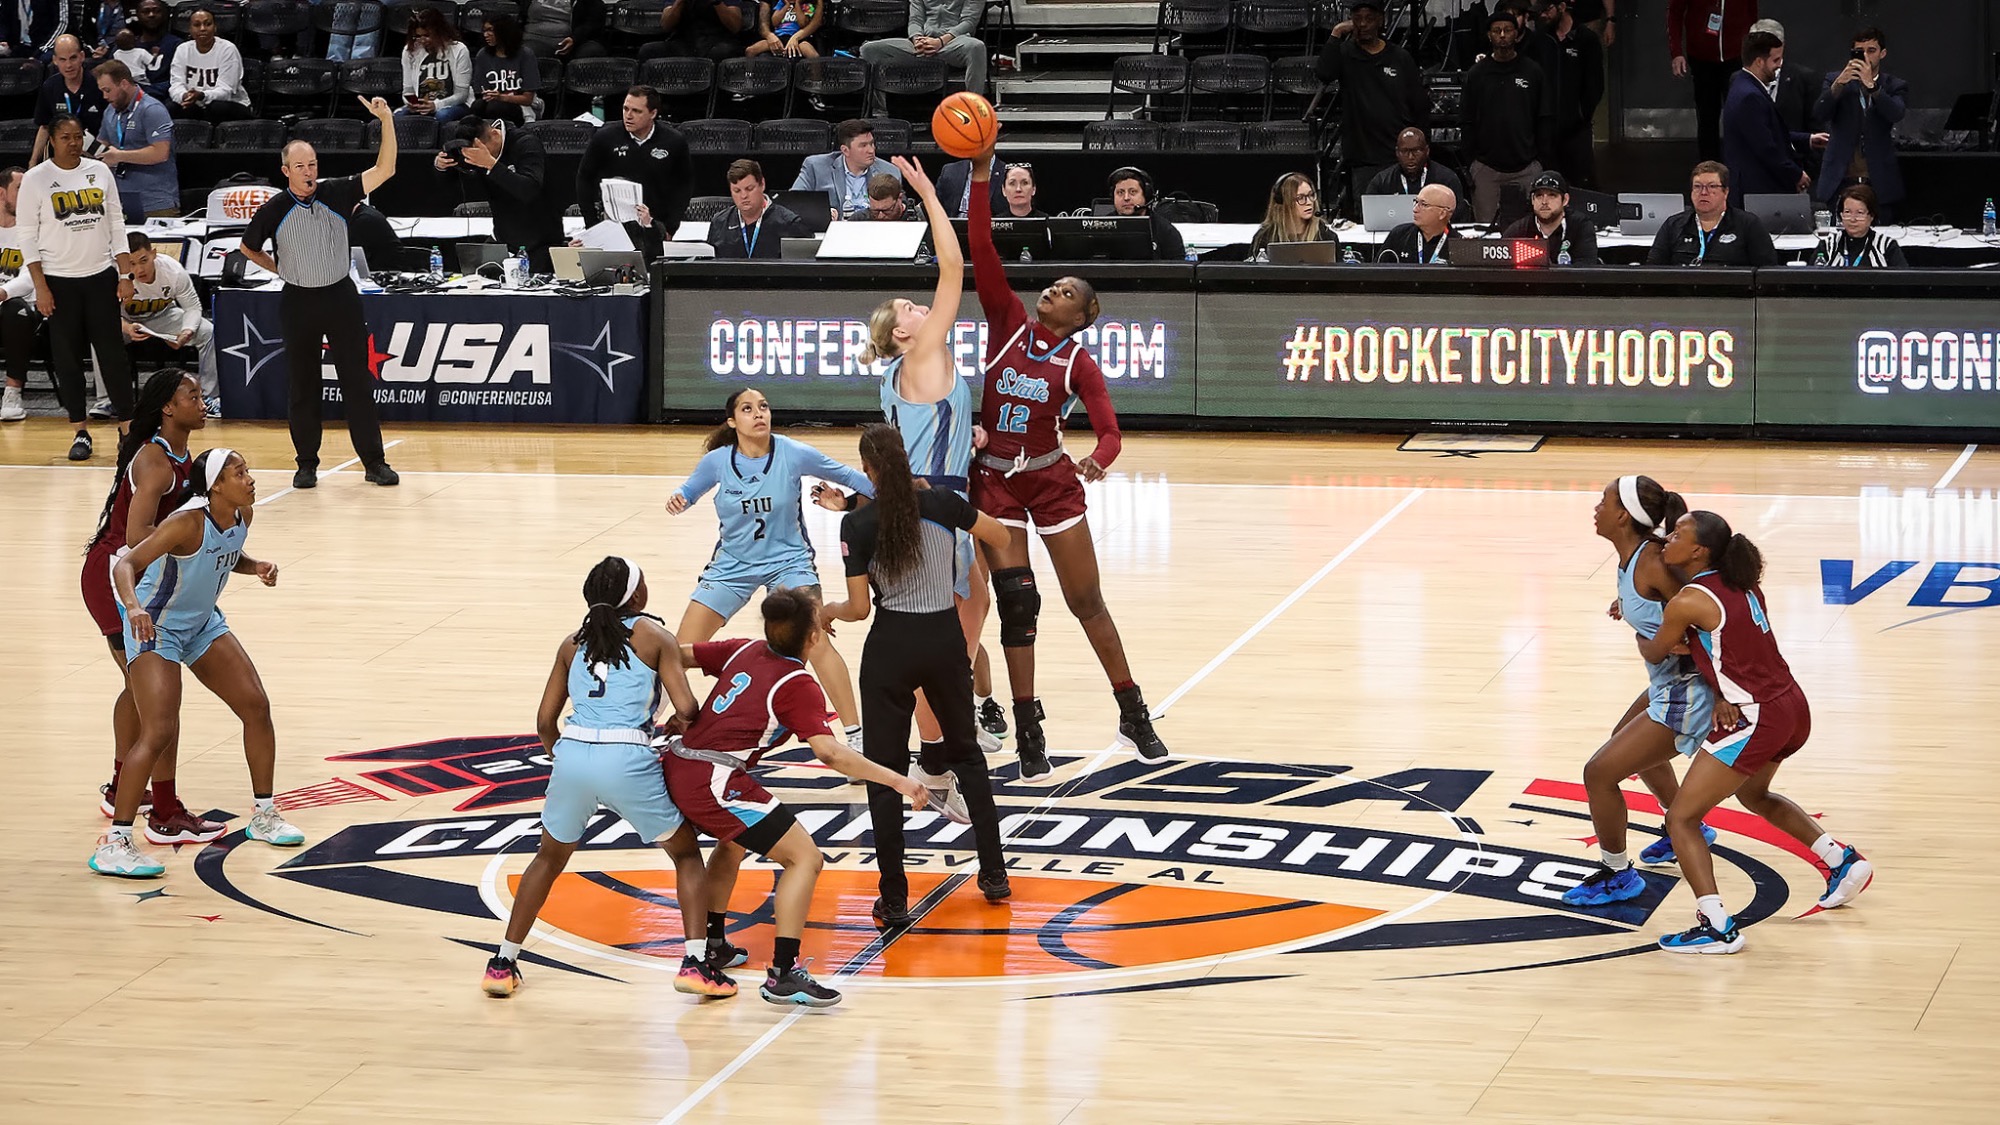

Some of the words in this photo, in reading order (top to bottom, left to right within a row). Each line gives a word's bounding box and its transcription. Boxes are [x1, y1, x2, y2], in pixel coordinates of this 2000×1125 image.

[186, 65, 219, 87] FIU
[51, 187, 105, 221] OUR
[64, 217, 102, 228] MOMENT
[1482, 246, 1512, 260] POSS.
[1283, 325, 1735, 388] #ROCKETCITYHOOPS
[1858, 330, 2000, 394] @CON
[996, 367, 1049, 403] State
[438, 390, 553, 407] @CONFERENCEUSA
[997, 402, 1030, 433] 12
[741, 496, 772, 516] FIU
[753, 517, 767, 541] 2
[214, 549, 239, 571] FIU
[1745, 589, 1770, 634] 4
[711, 671, 752, 715] 3
[1147, 866, 1225, 885] AL
